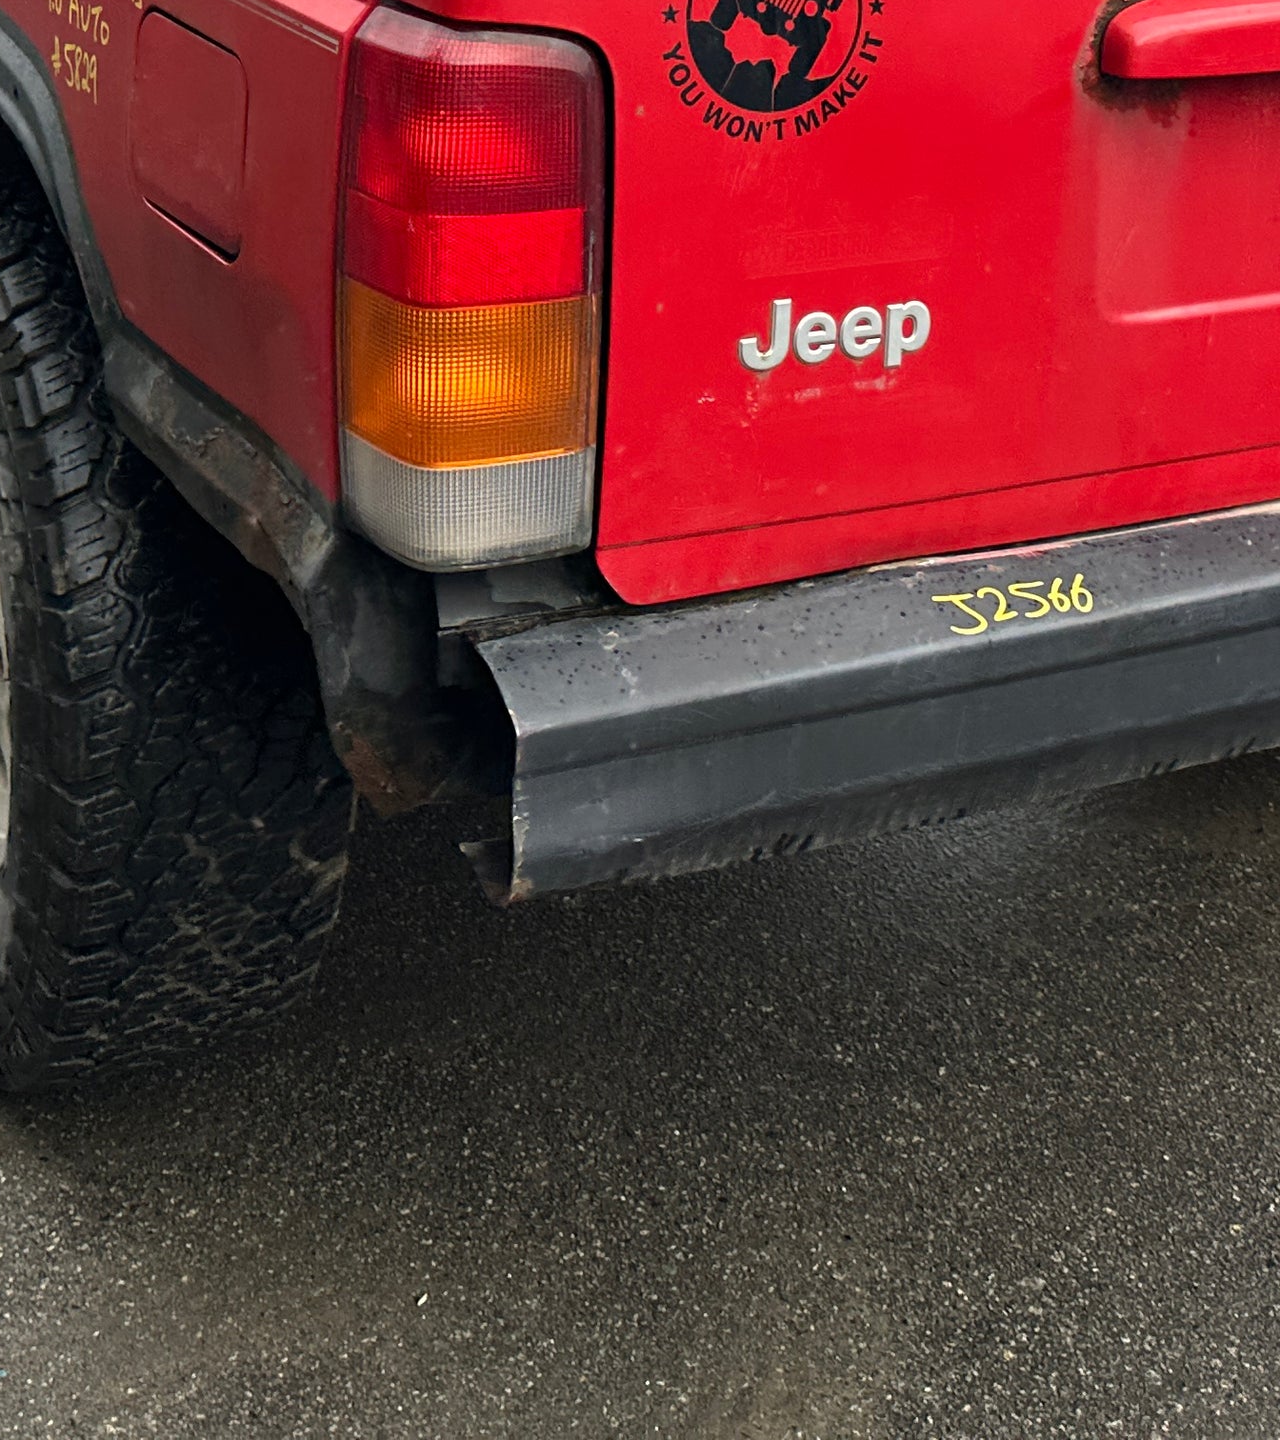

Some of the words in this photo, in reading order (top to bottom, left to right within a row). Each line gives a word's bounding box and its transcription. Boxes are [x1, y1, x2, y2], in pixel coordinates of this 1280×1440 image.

[662, 41, 705, 107] YOU
[701, 100, 787, 143] WON'T
[793, 66, 869, 137] MAKE
[859, 30, 884, 63] IT
[739, 298, 932, 373] Jeep
[931, 572, 1094, 636] J2566
